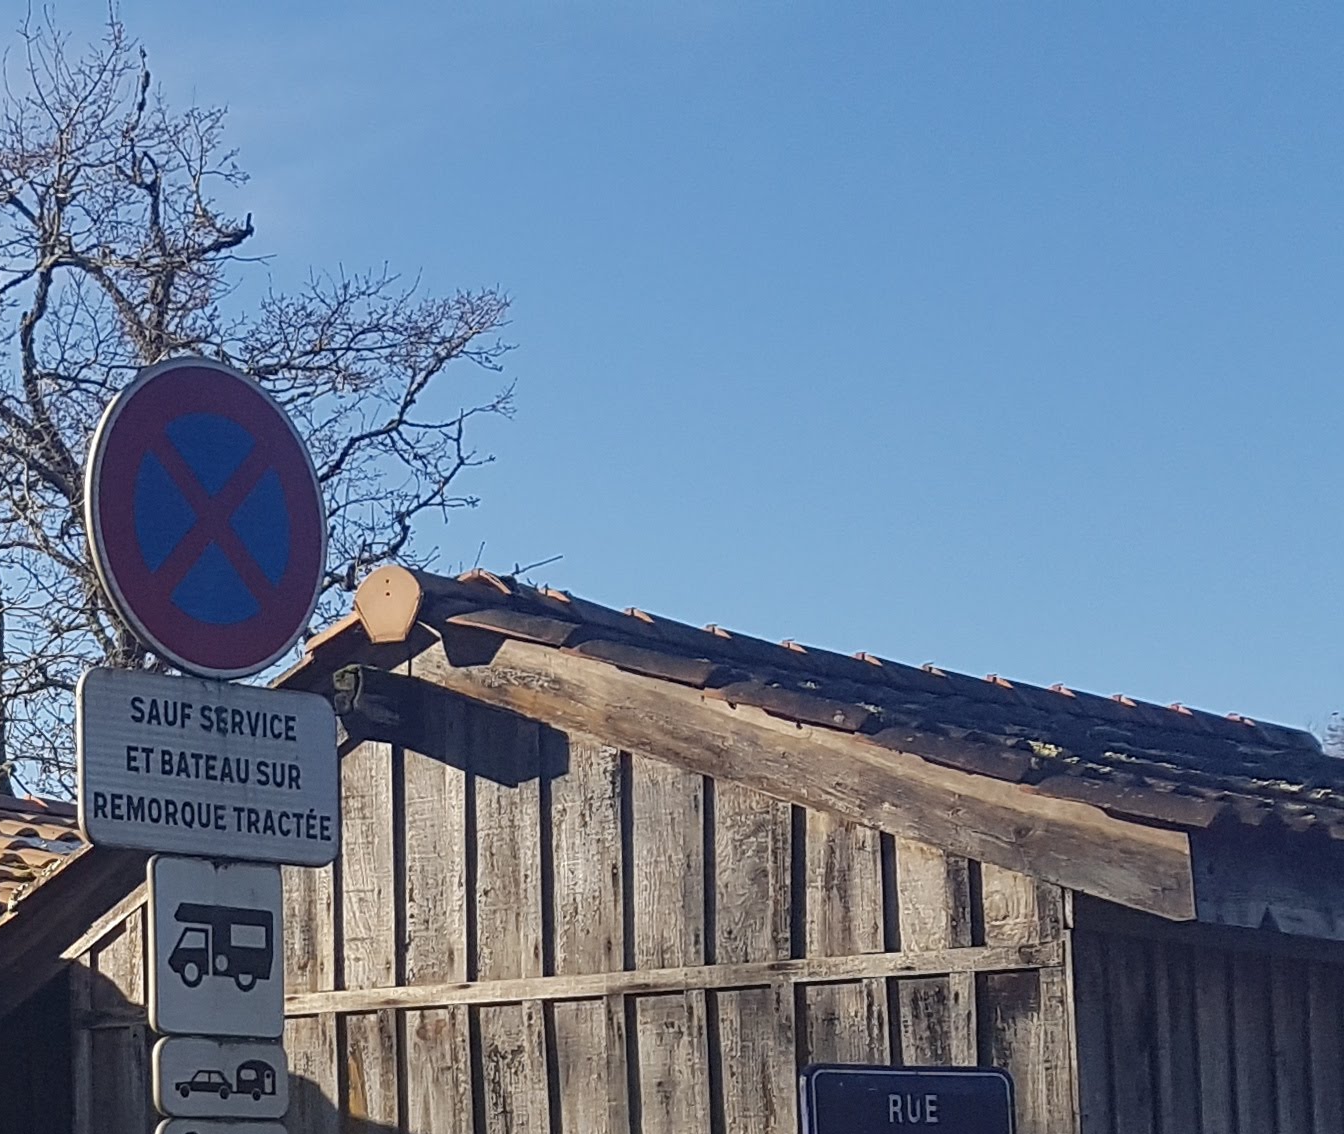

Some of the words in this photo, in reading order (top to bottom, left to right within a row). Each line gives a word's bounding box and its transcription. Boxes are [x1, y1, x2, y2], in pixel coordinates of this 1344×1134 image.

[130, 696, 193, 729] SAUF
[199, 704, 297, 742] SERVICE
[126, 745, 154, 774] ET
[161, 749, 249, 784] BATEAU
[256, 761, 302, 790] SUR
[93, 791, 227, 831] REMORQUE
[232, 808, 332, 841] TRACTÉE
[888, 1094, 939, 1123] RUE
